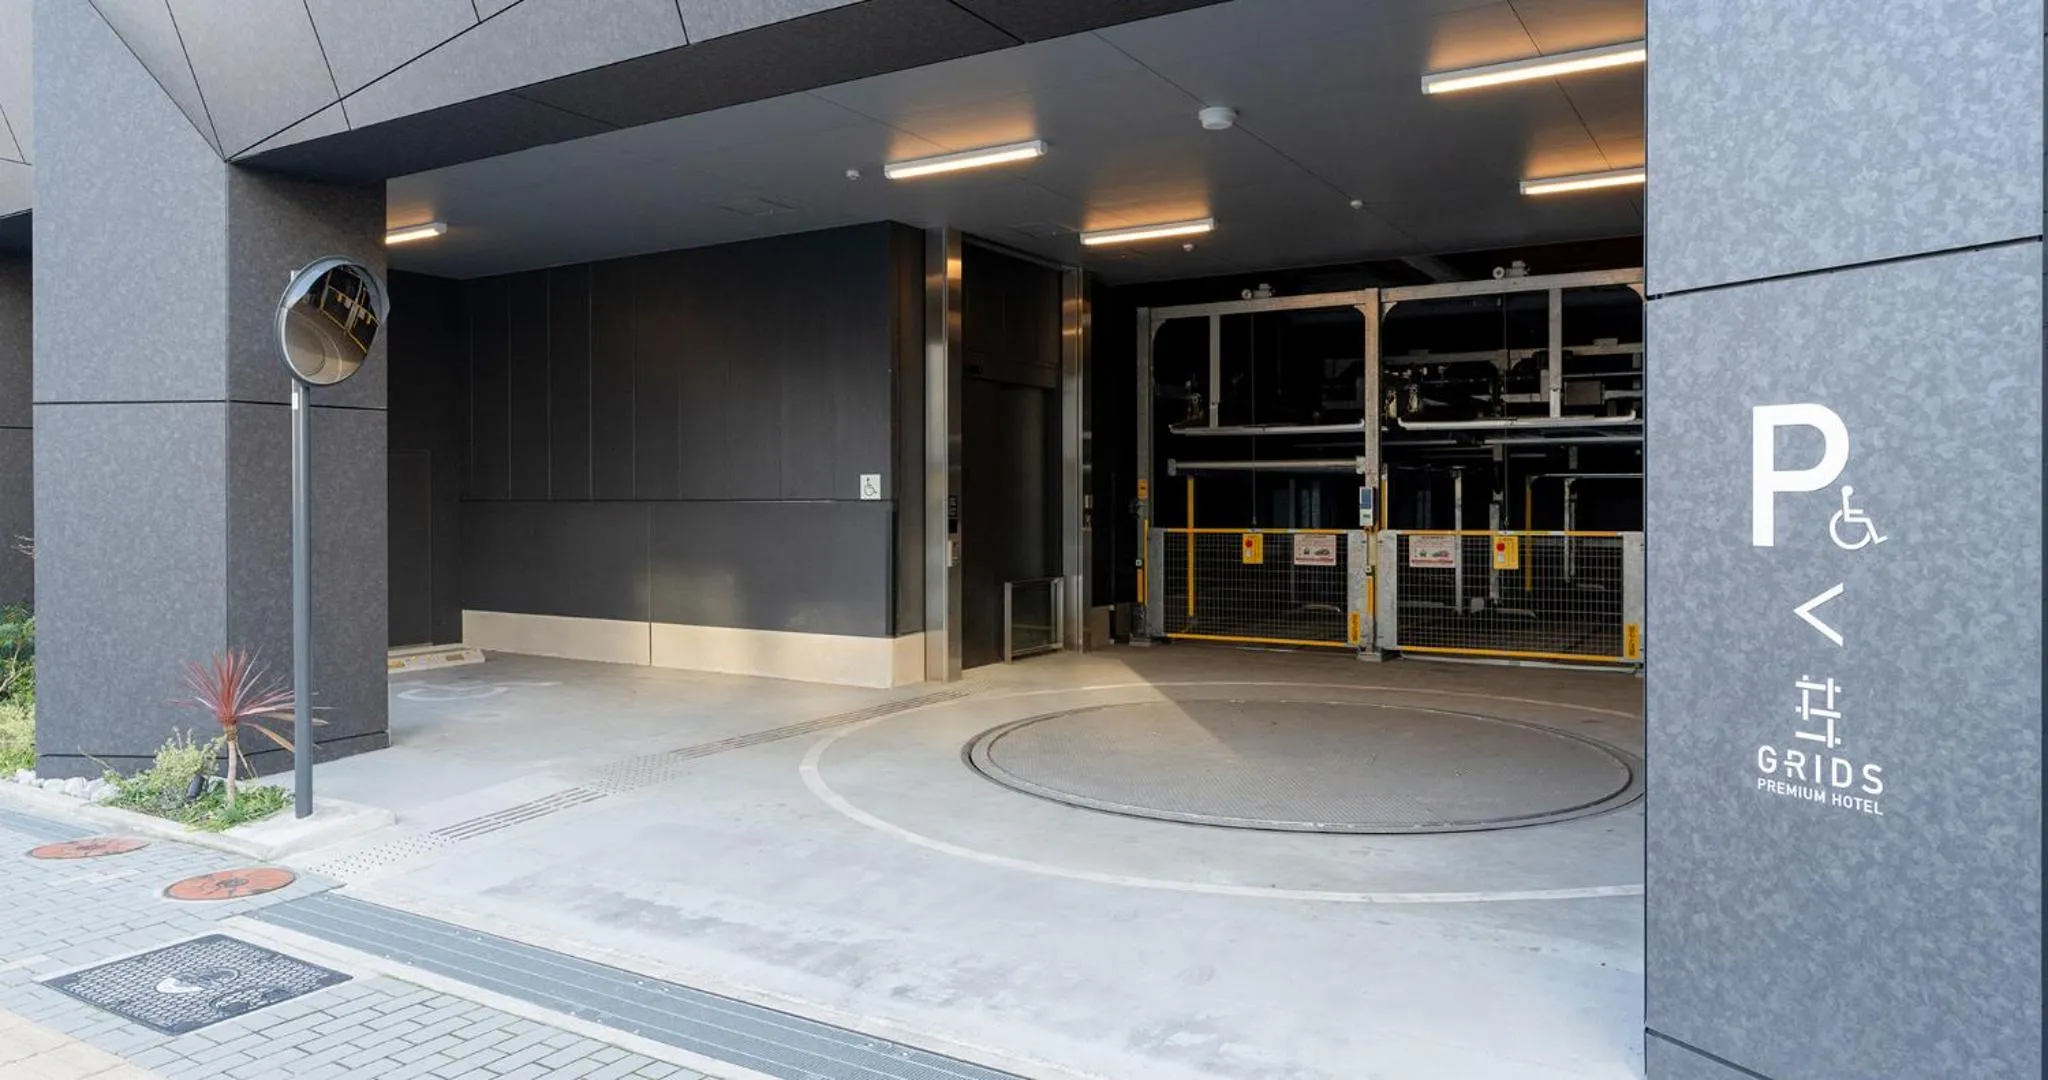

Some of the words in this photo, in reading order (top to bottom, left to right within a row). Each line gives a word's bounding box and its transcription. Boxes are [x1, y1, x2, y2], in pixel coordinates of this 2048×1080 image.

[1752, 402, 1850, 547] P
[1757, 744, 1884, 795] GRIDS
[1757, 777, 1827, 804] PREMIUM
[1831, 792, 1884, 816] HOTEL
